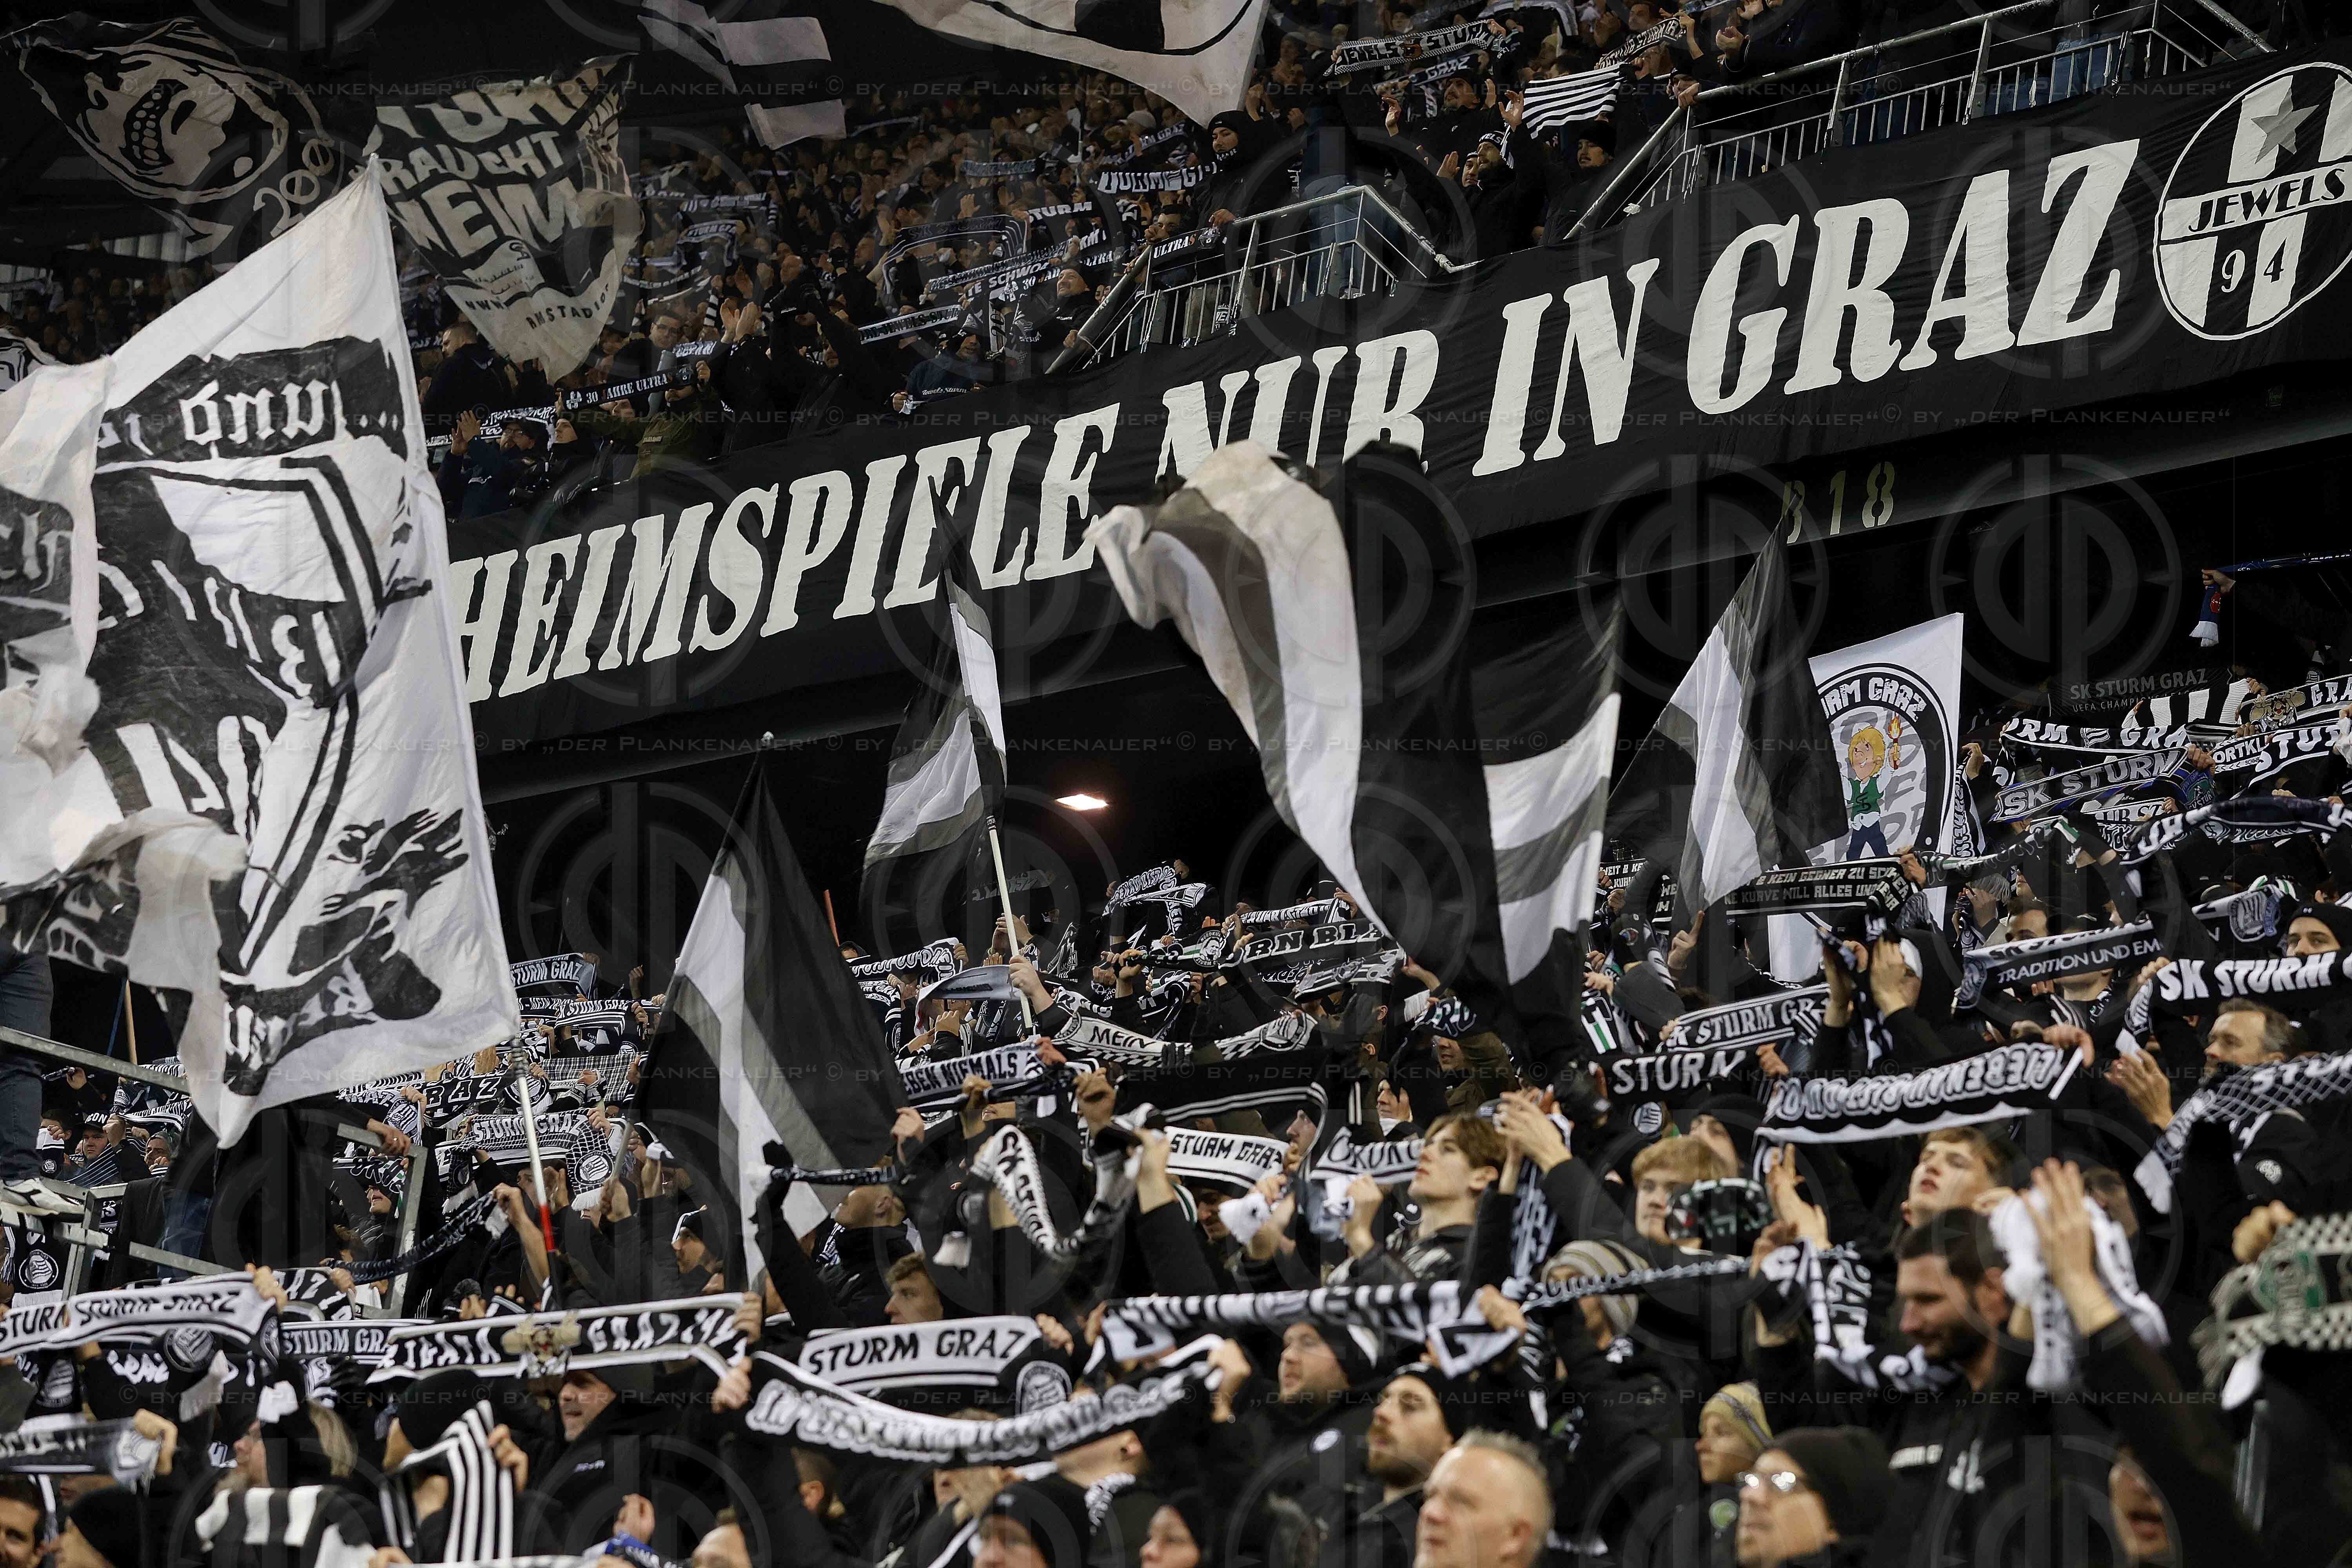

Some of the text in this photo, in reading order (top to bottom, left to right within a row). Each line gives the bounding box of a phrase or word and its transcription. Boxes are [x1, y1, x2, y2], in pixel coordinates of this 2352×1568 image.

[2187, 167, 2346, 232] JEWELS
[1153, 230, 1196, 259] ULTRAS
[2220, 237, 2288, 293] 94
[1022, 278, 1036, 294] 30
[586, 390, 599, 405] 30
[449, 403, 1123, 704] HEIMSPIELE
[1155, 329, 1440, 476] NUR
[1472, 256, 1661, 477] IN
[1686, 139, 2140, 416] GRAZ
[2070, 668, 2209, 701] SK STURM GRAZ
[2073, 704, 2096, 713] UEFA
[2062, 750, 2181, 795] STURM
[1768, 872, 1797, 885] KEIN
[1798, 868, 1846, 882] GEGNER
[1847, 867, 1866, 879] ZU
[1814, 884, 1853, 898] ALLES
[551, 961, 584, 981] GRAZ
[1998, 954, 2089, 984] TRADITION
[2091, 942, 2131, 965] UND
[2156, 951, 2336, 1001] SK STURM
[1089, 1025, 1153, 1049] MEIN
[1695, 1004, 1777, 1044] STURM
[537, 1114, 583, 1135] GRAZ
[1170, 1133, 1232, 1159] STURM
[282, 1327, 350, 1356] STURM
[808, 1327, 1029, 1375] STURM GRAZ
